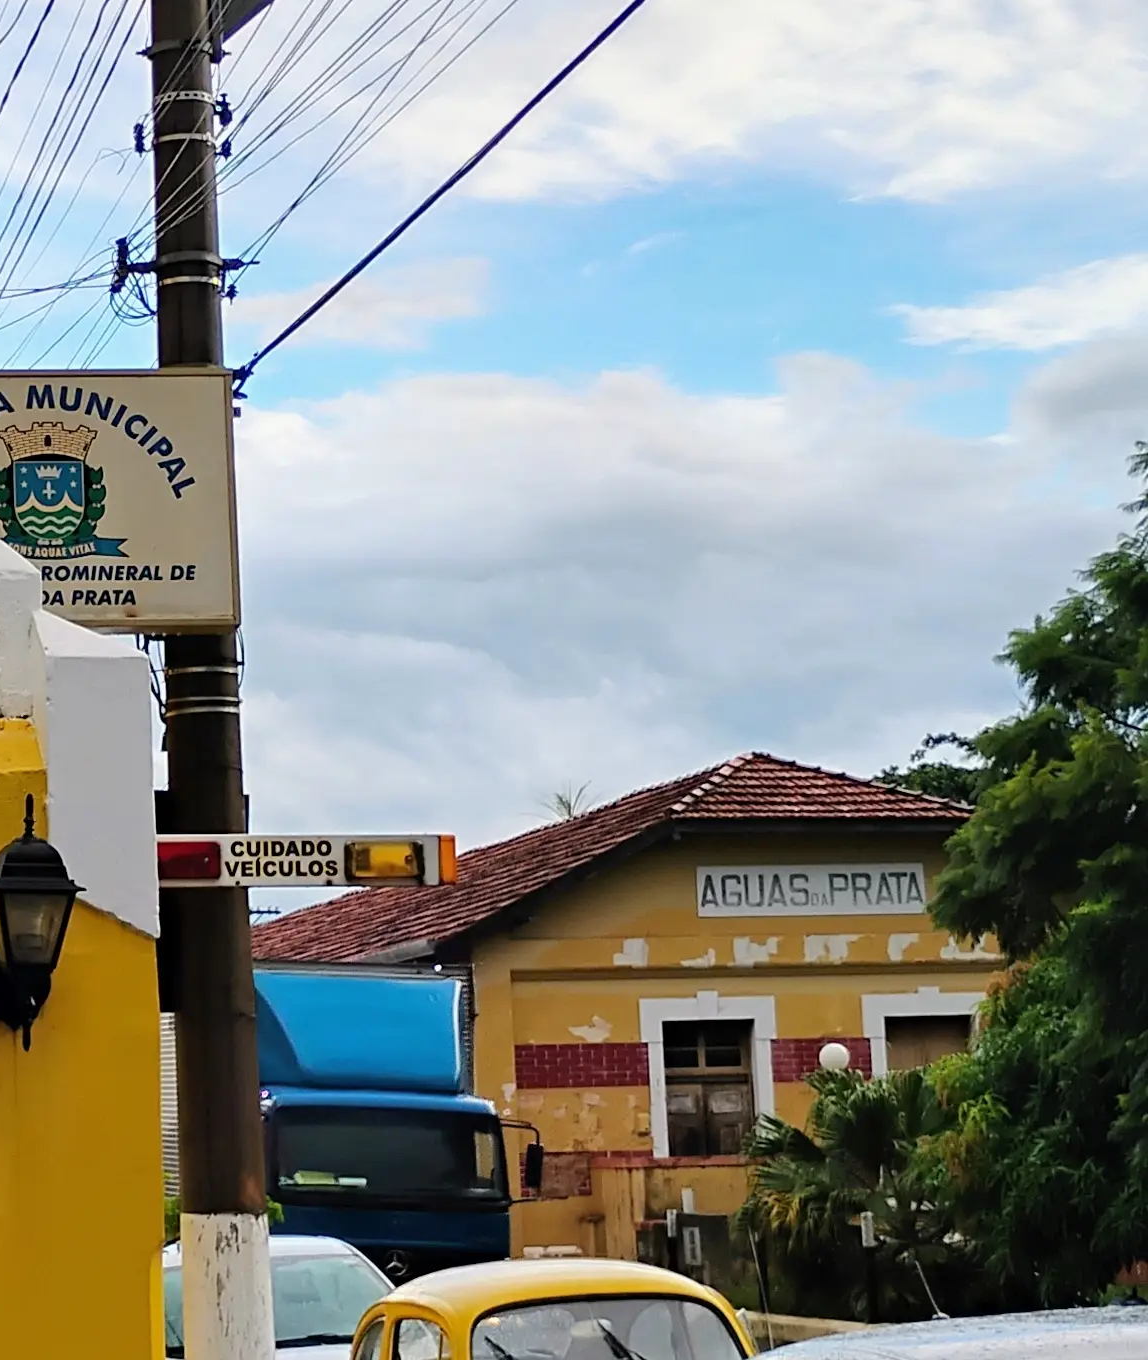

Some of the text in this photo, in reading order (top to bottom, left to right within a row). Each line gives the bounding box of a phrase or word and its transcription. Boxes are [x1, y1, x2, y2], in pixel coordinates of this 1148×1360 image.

[26, 384, 196, 500] MUNICIPAL
[34, 546, 67, 557] AQUAE
[68, 542, 96, 556] VITAE
[41, 564, 163, 582] ROMINERAL
[170, 564, 196, 581] DE
[71, 589, 137, 606] PRATA
[230, 840, 332, 857] CUIDADO
[225, 857, 338, 877] VEÍCULOS
[701, 871, 924, 908] AGUAS DA PRATA
